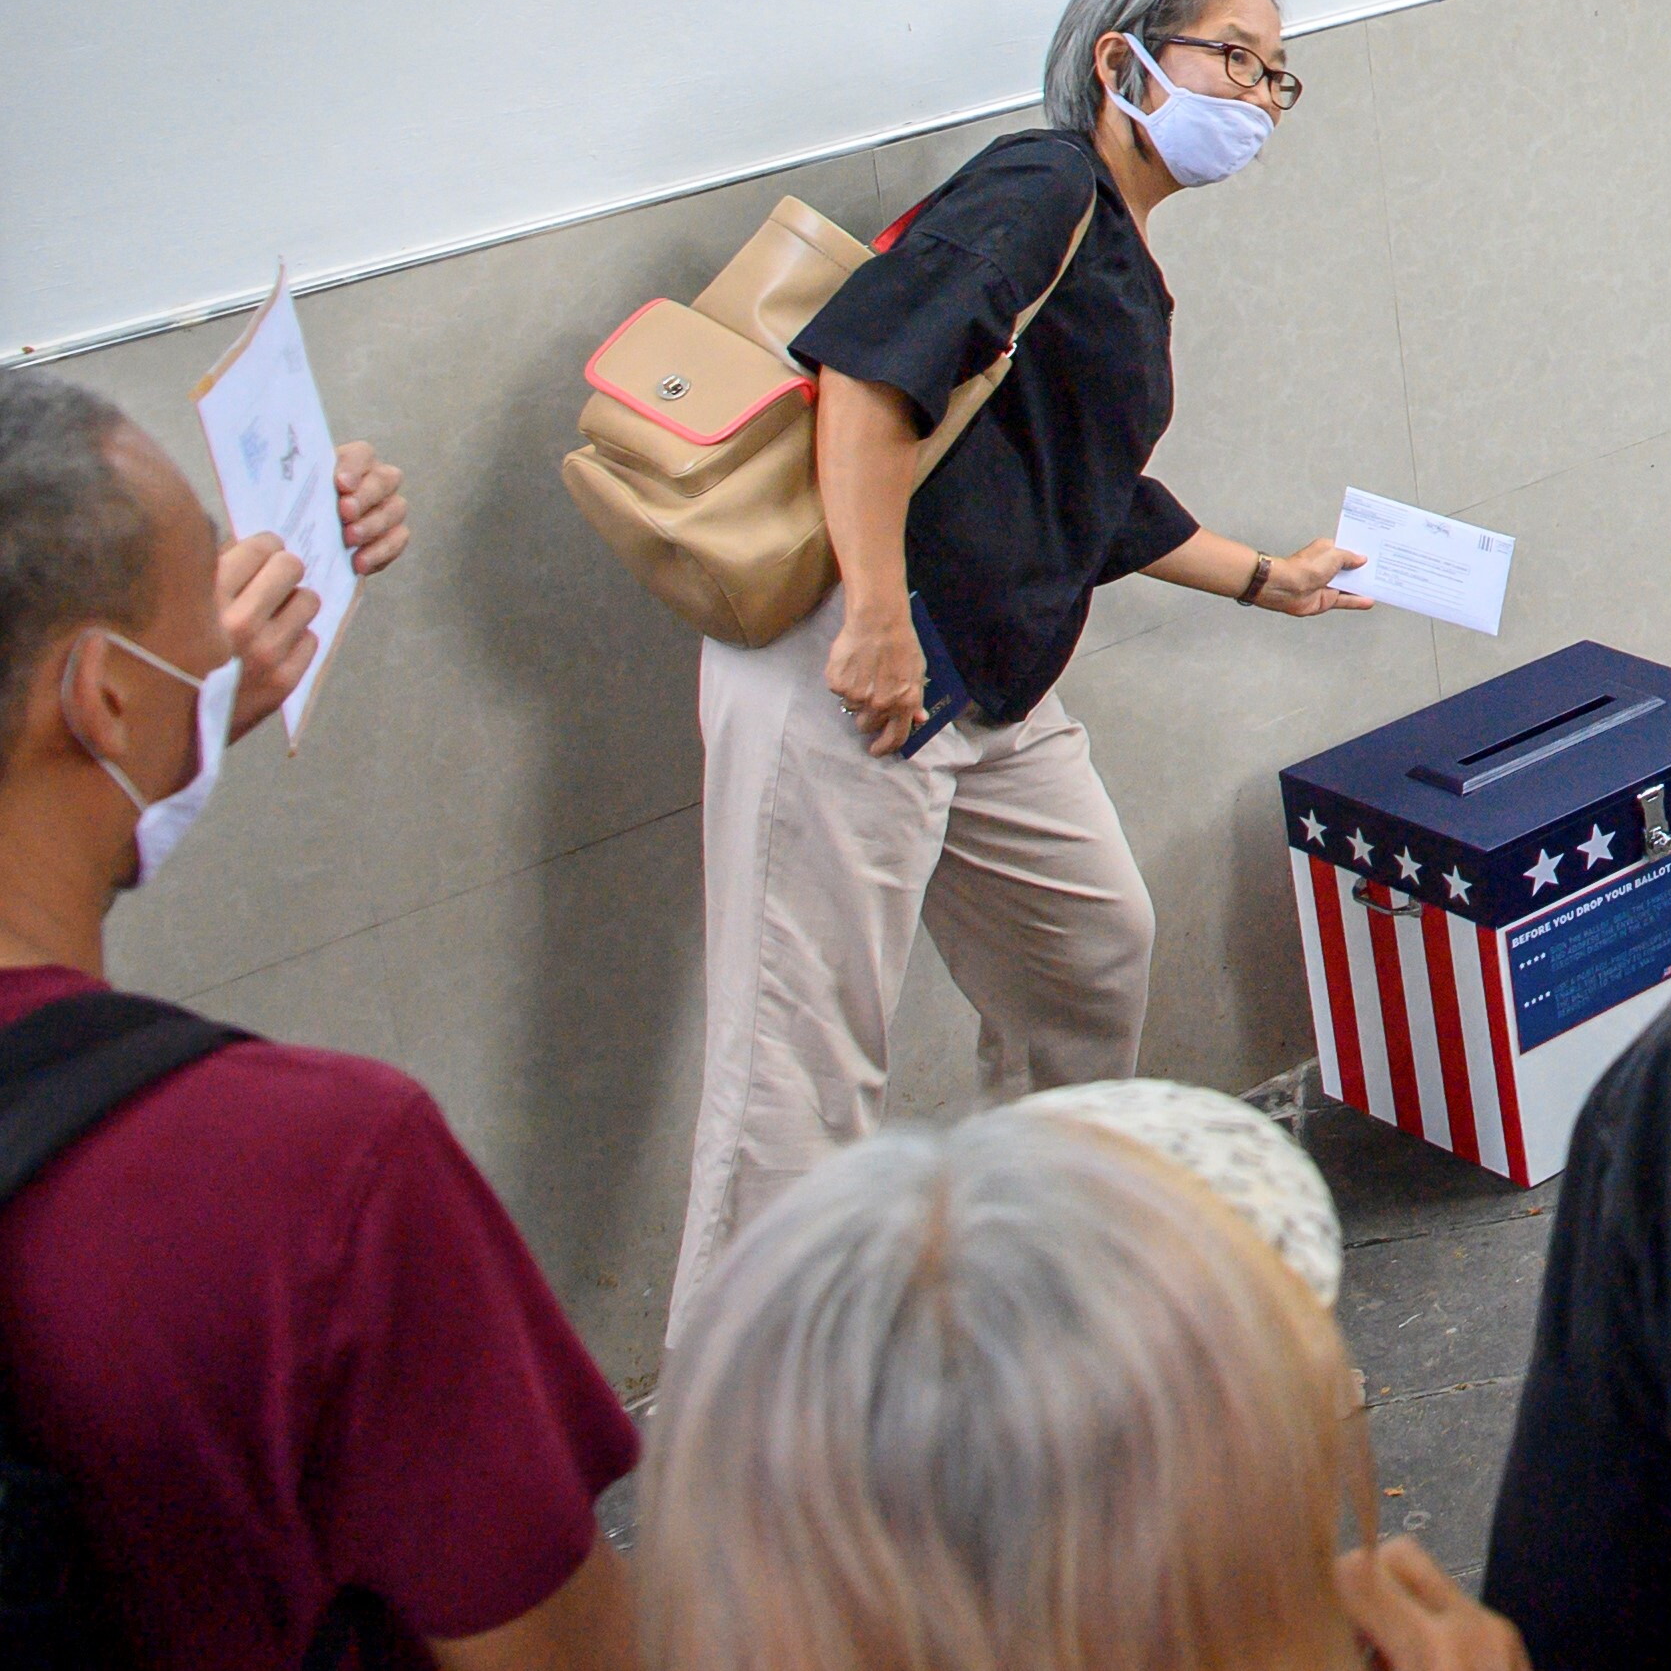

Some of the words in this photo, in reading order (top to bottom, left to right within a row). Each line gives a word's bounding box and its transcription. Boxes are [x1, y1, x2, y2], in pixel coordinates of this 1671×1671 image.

[1512, 922, 1552, 948] BEFORE
[1553, 911, 1575, 928] YOU
[1576, 897, 1604, 917] DROP
[1605, 883, 1632, 903] YOUR
[1634, 865, 1671, 888] BALLOT
